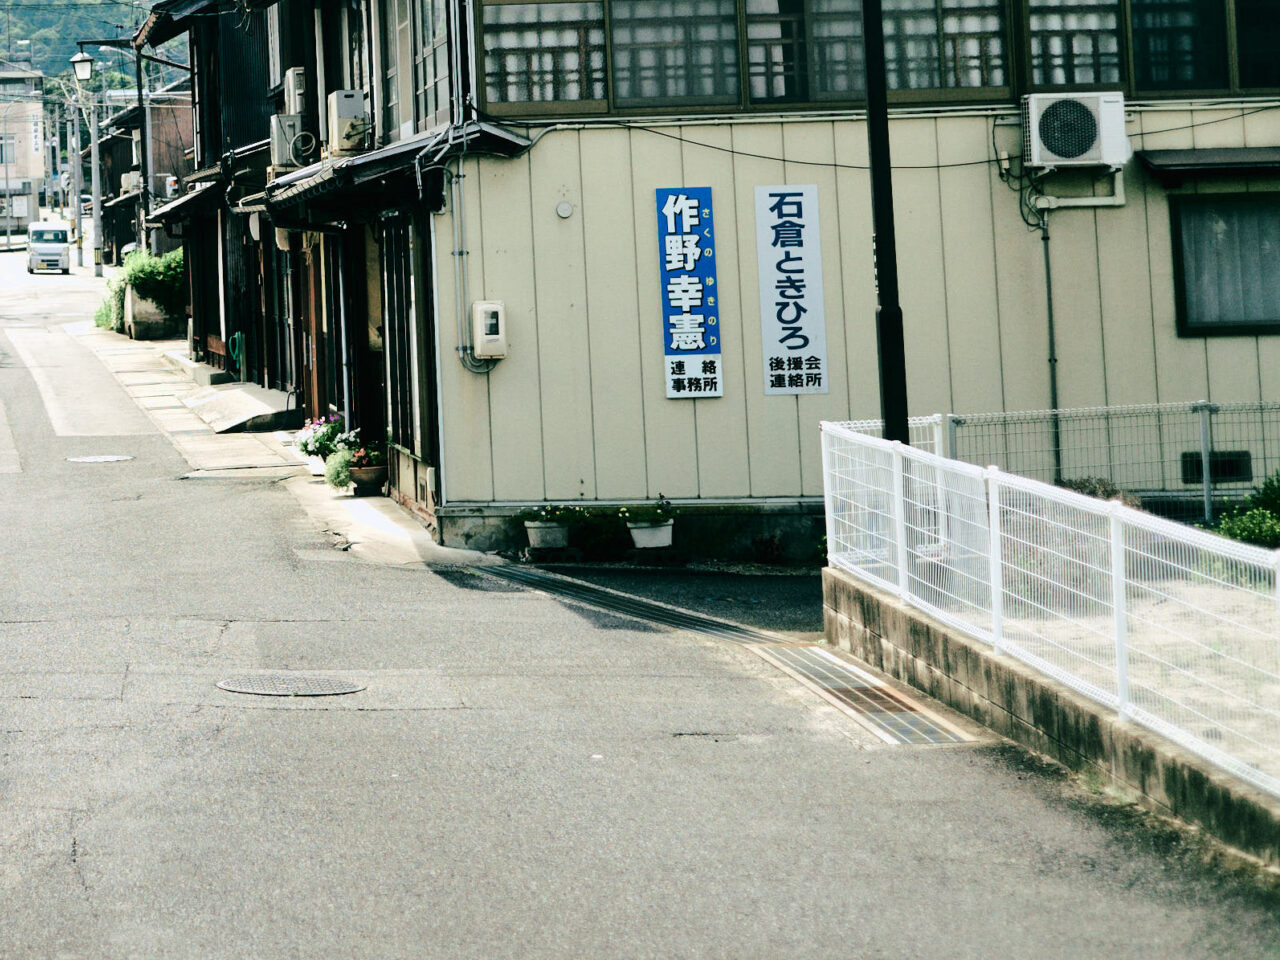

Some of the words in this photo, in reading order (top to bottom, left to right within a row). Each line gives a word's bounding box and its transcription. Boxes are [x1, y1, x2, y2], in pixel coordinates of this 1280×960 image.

[662, 194, 708, 351] 作野幸憲
[768, 192, 810, 350] 石倉ときひろ
[769, 355, 822, 371] 後援会
[671, 377, 718, 393] 事務所
[769, 373, 822, 388] 連絡所
